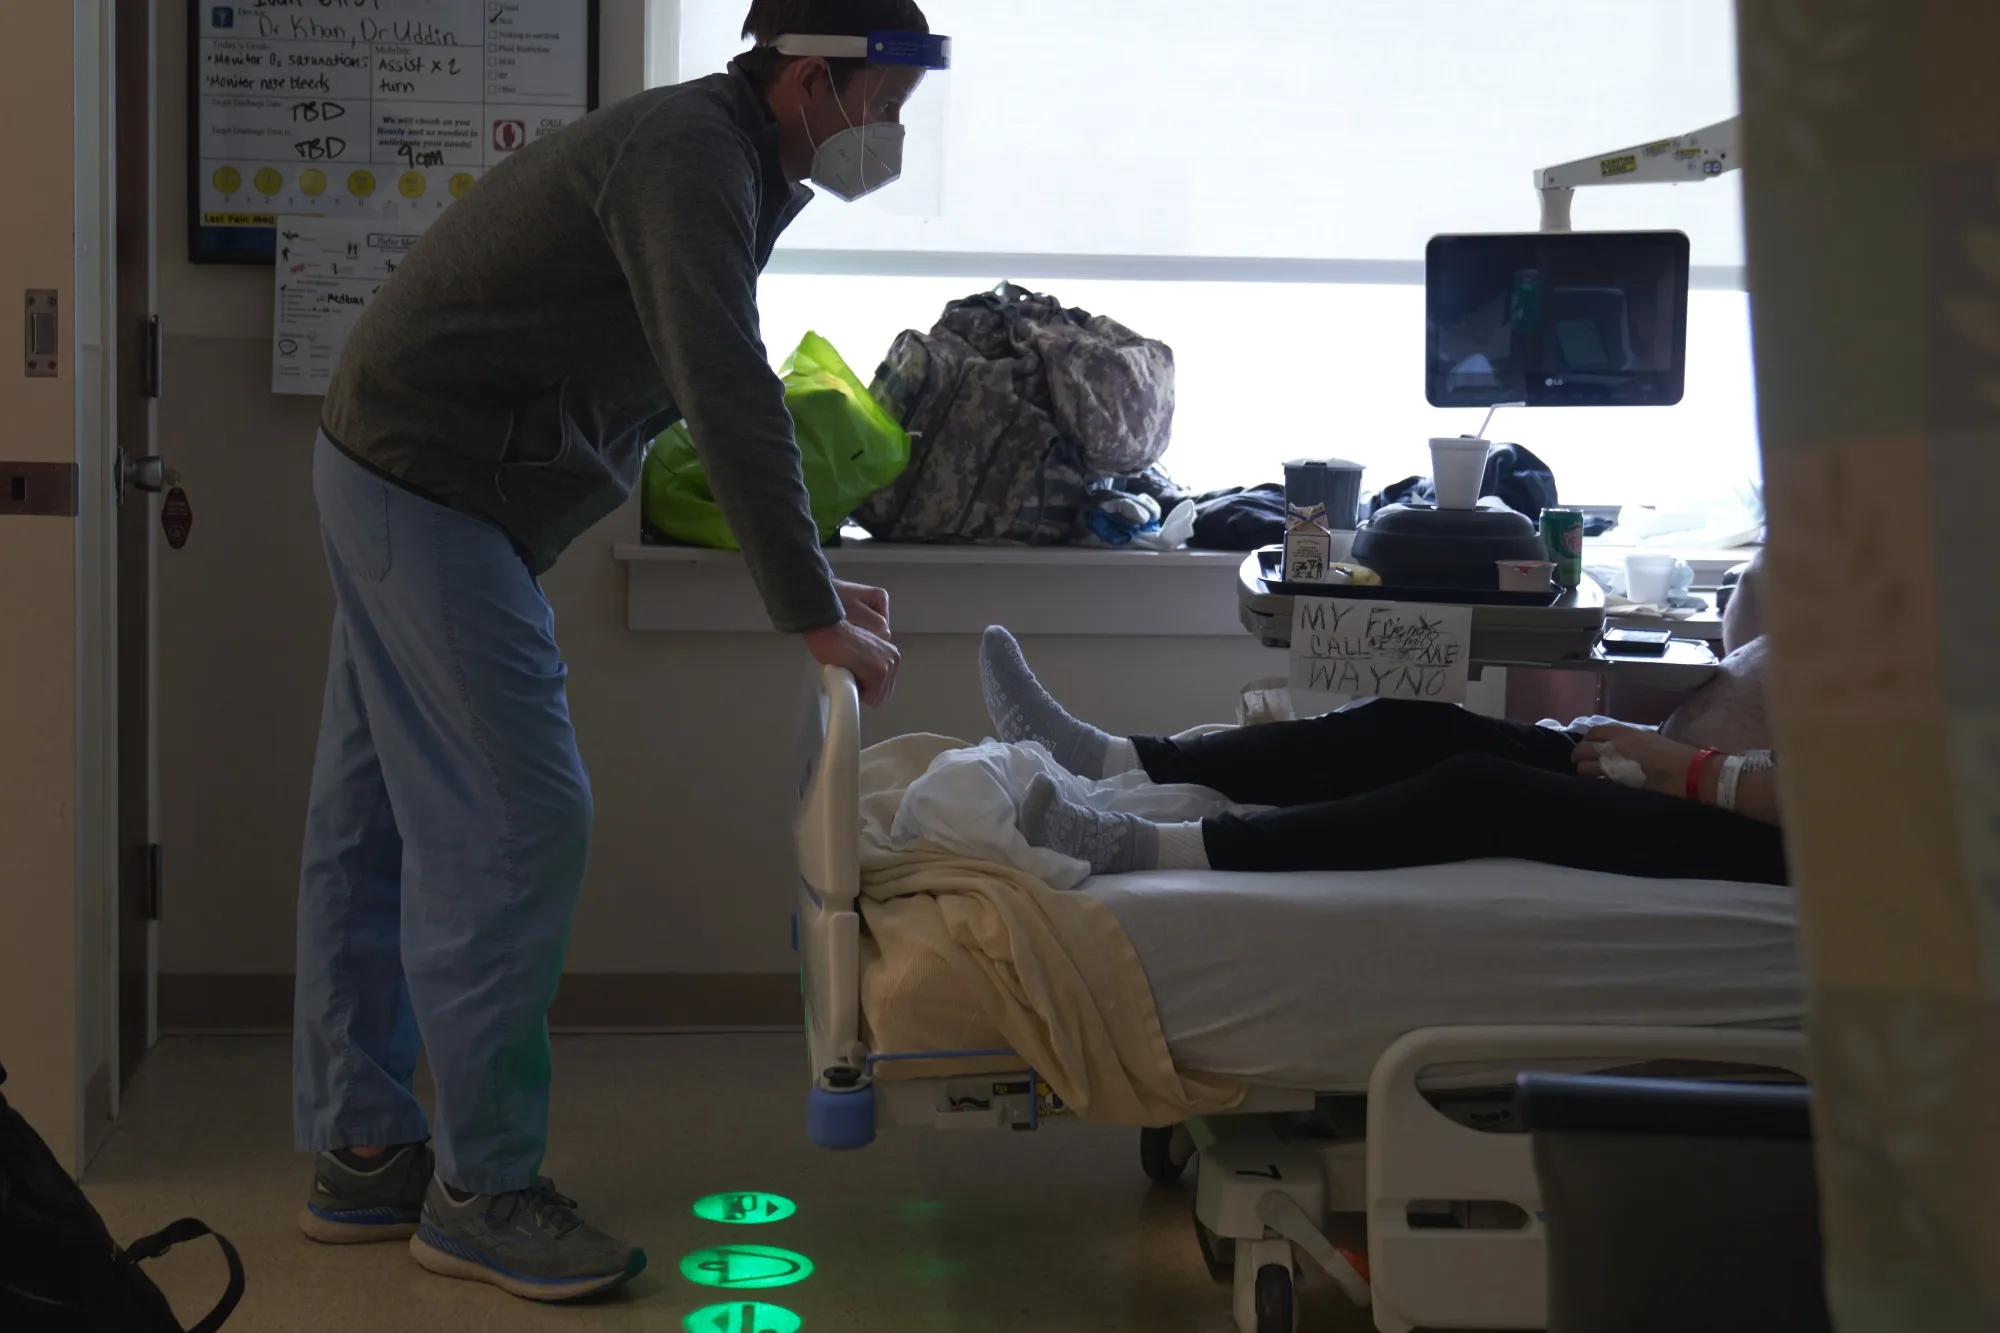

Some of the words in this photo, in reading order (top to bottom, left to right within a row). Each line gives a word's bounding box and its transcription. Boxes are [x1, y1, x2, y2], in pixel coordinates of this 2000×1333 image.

[259, 14, 281, 37] Dr
[360, 16, 389, 42] Dr
[393, 20, 459, 46] Uddin
[213, 53, 262, 66] Monitor
[378, 57, 424, 73] Assist
[448, 58, 462, 75] 2
[209, 74, 255, 89] Monitor
[290, 73, 331, 93] bleeds
[379, 78, 415, 94] turn
[288, 101, 345, 122] TBD
[398, 116, 414, 125] will
[415, 117, 440, 125] check
[455, 119, 471, 128] you
[407, 128, 424, 136] and
[437, 129, 468, 137] needed
[294, 136, 346, 160] TBD
[264, 196, 270, 204] 2
[205, 213, 224, 223] Last
[228, 215, 249, 224] Pain
[253, 215, 274, 225] Med
[1301, 601, 1354, 633] MY
[1310, 634, 1372, 656] CALL
[1417, 643, 1461, 665] ME
[1309, 659, 1446, 697] WAYNO
